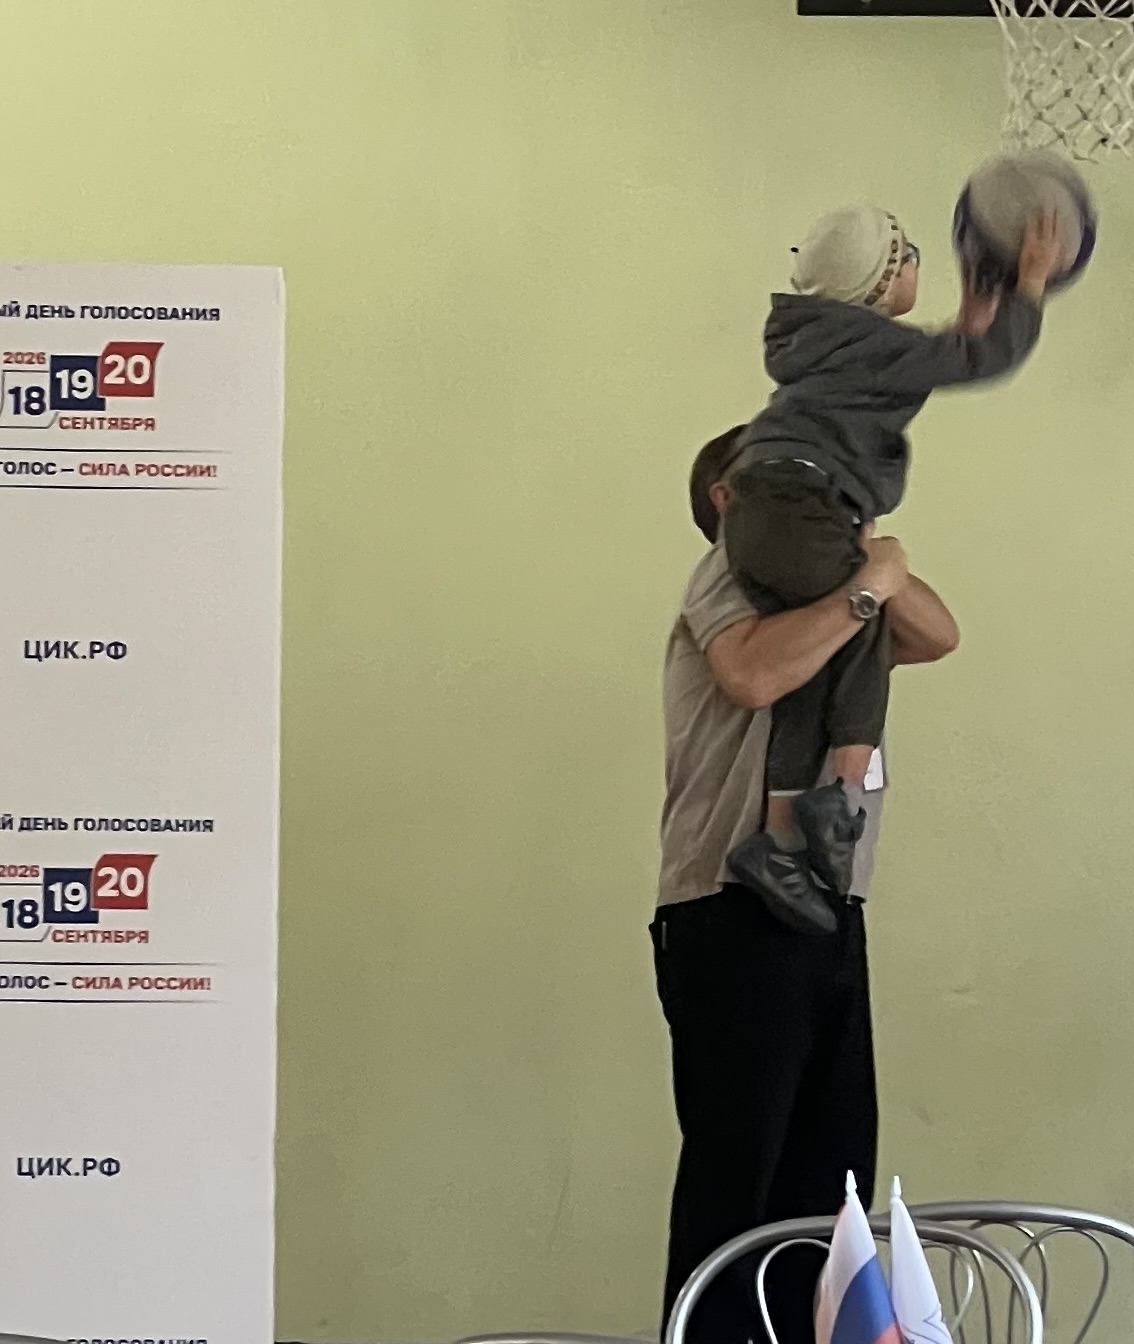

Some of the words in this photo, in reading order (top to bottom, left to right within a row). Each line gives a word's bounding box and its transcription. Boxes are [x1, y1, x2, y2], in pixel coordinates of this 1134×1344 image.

[25, 305, 75, 319] ДЕНЬ
[80, 306, 220, 321] ГОЛОСОВАНИЯ
[3, 352, 46, 365] 2026
[8, 386, 47, 416] 18
[56, 369, 94, 399] 19
[103, 355, 150, 385] 20
[59, 417, 155, 431] СЕНТЯБРЯ
[0, 462, 57, 475] ОЛОС
[79, 463, 130, 476] СИЛА
[135, 464, 218, 477] РОССИИ!
[24, 640, 127, 662] ЦИК.РФ
[18, 817, 68, 832] ДЕНЬ
[74, 818, 214, 832] ГОЛОСОВАНИЯ
[0, 865, 40, 877] 2026
[2, 899, 39, 929] 18
[48, 882, 87, 912] 19
[97, 867, 144, 897] 20
[52, 930, 149, 943] СЕНТЯБРЯ
[72, 977, 123, 990] СИЛА
[128, 977, 211, 990] РОССИИ!
[17, 1157, 120, 1179] ЦИК.РФ
